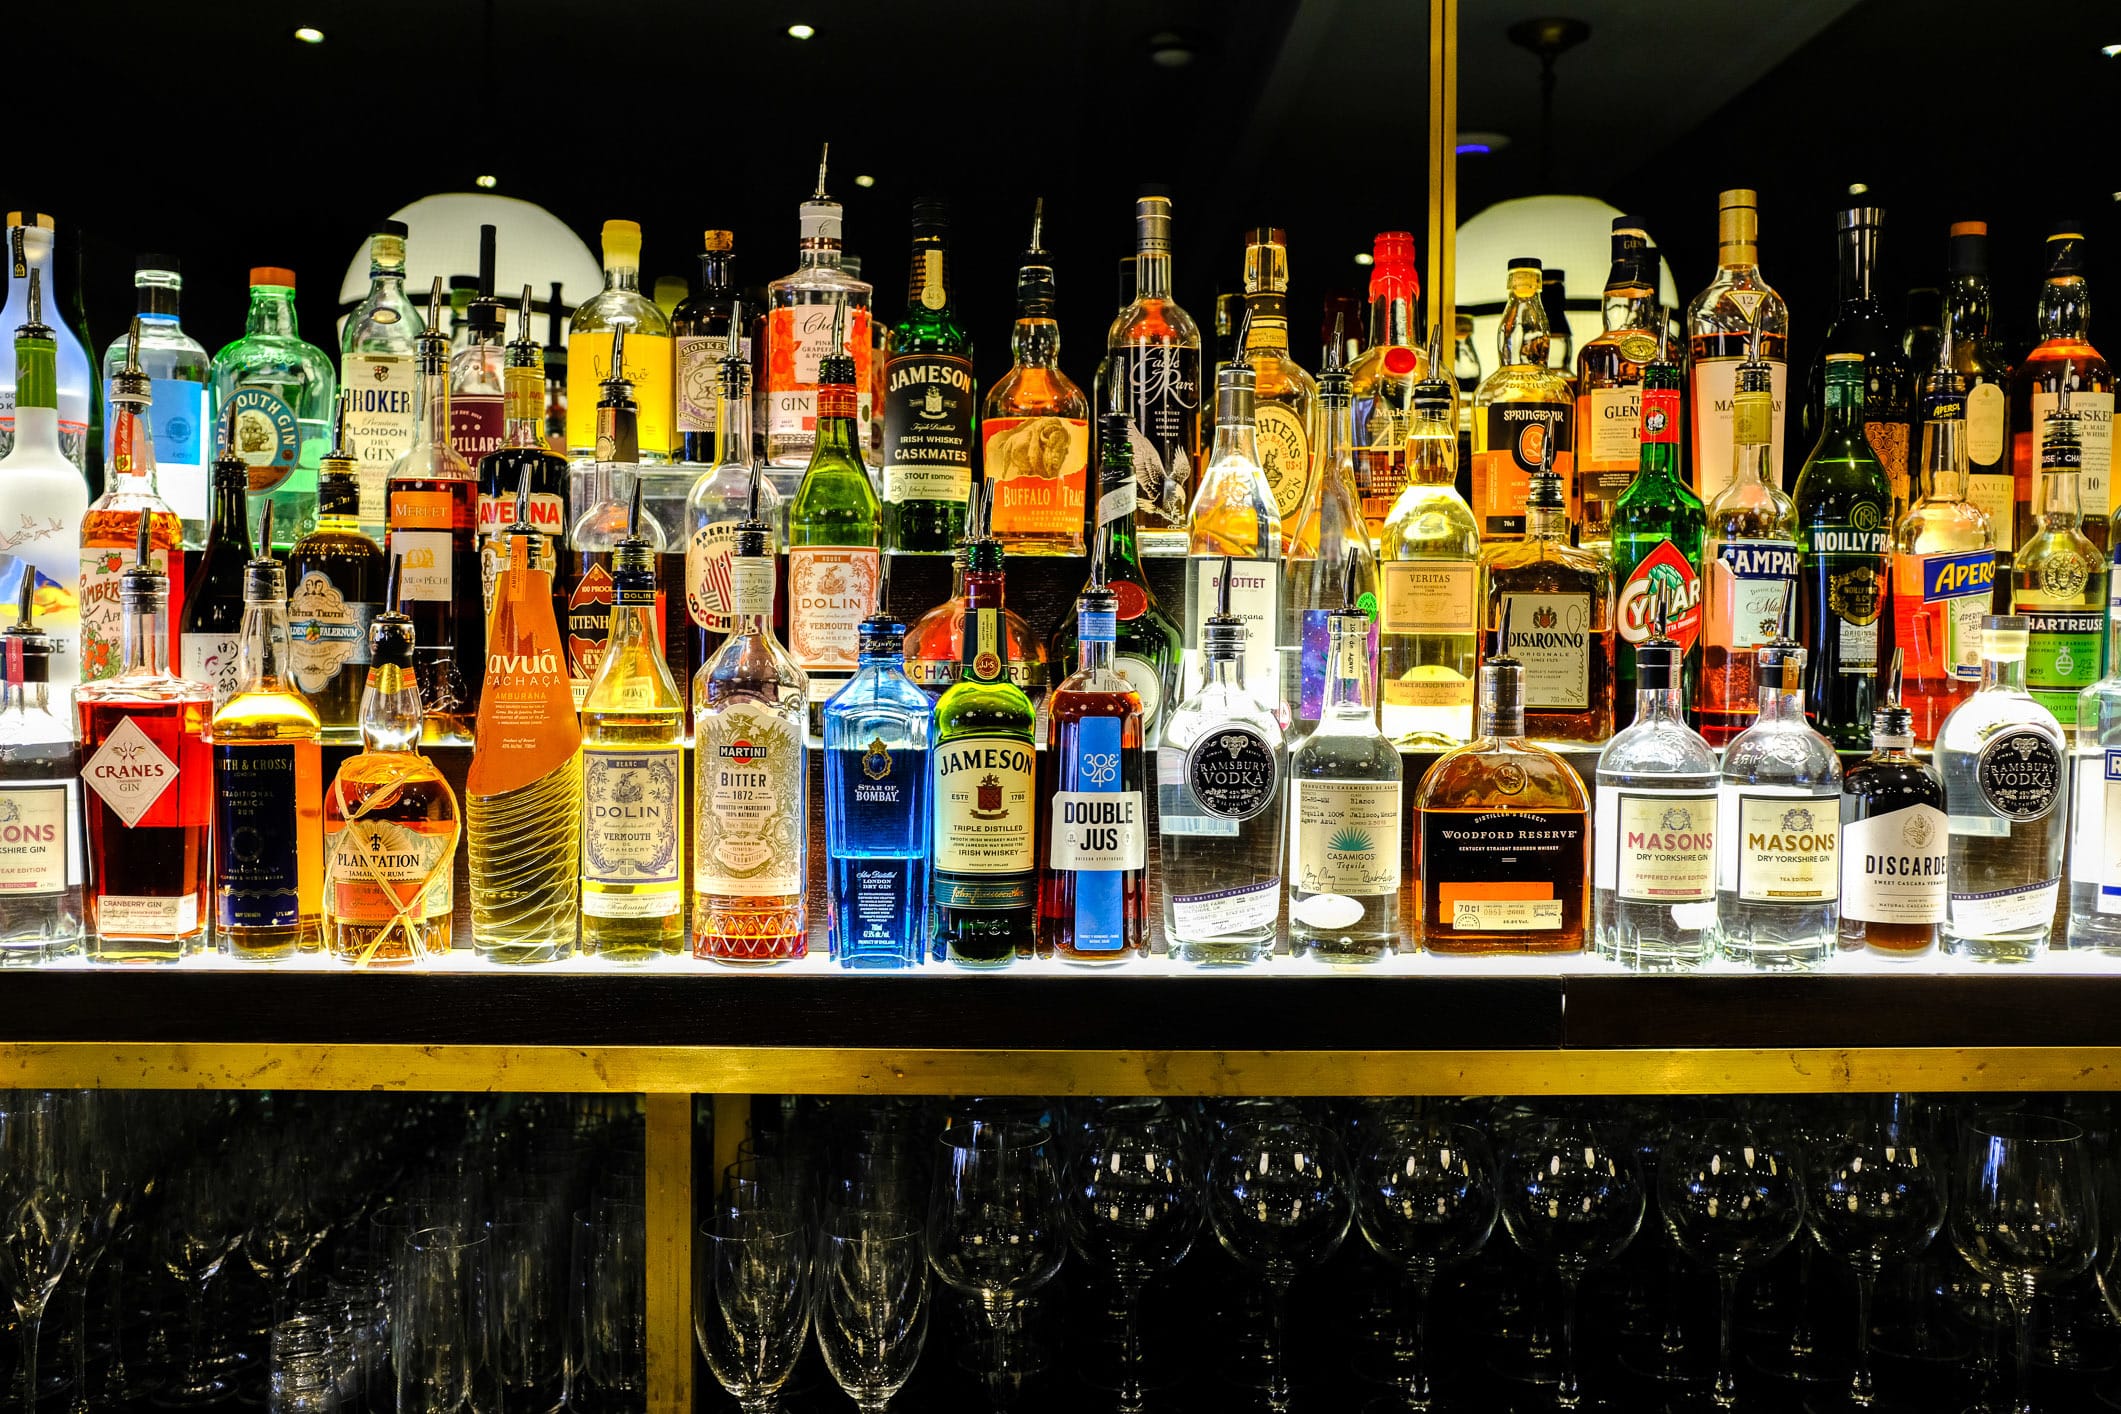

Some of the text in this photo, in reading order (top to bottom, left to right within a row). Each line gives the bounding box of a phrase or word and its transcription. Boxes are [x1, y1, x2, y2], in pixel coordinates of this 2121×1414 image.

[1742, 295, 1753, 305] 12
[803, 309, 833, 334] Cha
[681, 341, 729, 357] MONKEY
[889, 365, 971, 395] JAMESON
[344, 388, 411, 413] BROKER
[781, 397, 810, 411] GIN
[1714, 400, 1782, 412] MAAN
[217, 392, 297, 446] PLYOUTH GIN
[1375, 407, 1412, 418] Make
[2043, 409, 2113, 422] TISKER
[353, 426, 408, 438] LONDON
[370, 438, 390, 447] DRY
[900, 435, 964, 446] IRISH WHISKEY
[364, 446, 395, 462] GIN
[894, 448, 968, 463] CASKMATES
[904, 472, 954, 481] STOUT EDITION
[2087, 477, 2100, 490] 10
[1003, 486, 1050, 508] BUFFALO
[395, 503, 448, 518] MERLET
[480, 501, 561, 525] AVENA
[695, 526, 736, 546] APERI
[702, 534, 736, 550] AMERIC
[1814, 531, 1891, 552] NOILLY PRA
[1722, 548, 1799, 576] CAMPAR
[1409, 574, 1451, 583] VERITAS
[1934, 558, 1995, 593] APERO
[581, 585, 613, 593] 100 PROO
[1212, 577, 1266, 589] BOTTET
[802, 598, 861, 609] DOLIN
[315, 609, 344, 619] TRUTH
[688, 593, 732, 628] COCCHI
[809, 622, 853, 631] VERMOUTH
[2029, 617, 2104, 631] HARTREUSE
[291, 627, 359, 639] LDEN FALERNUM
[1510, 632, 1584, 649] DISARONNO
[488, 648, 558, 675] avuá
[582, 653, 603, 665] RY
[913, 665, 1032, 681] CHARD
[486, 675, 561, 688] CACHAÇA
[495, 692, 547, 700] AMBURANA
[720, 746, 766, 757] MARTINI
[216, 758, 287, 771] ITH & CROSS
[940, 748, 1033, 777] JAMESON
[1200, 761, 1267, 773] RAMSBURY
[1990, 762, 2055, 773] RAMSBURY
[94, 764, 164, 779] CRANES
[721, 772, 767, 787] BITTER
[1202, 771, 1264, 787] VODKA
[1993, 772, 2053, 788] VODKA
[119, 782, 140, 792] GIN
[732, 790, 753, 801] 1872
[855, 790, 899, 802] BOMBAY
[595, 806, 660, 818] DOLIN
[1064, 801, 1134, 824] DOUBLE
[1301, 809, 1325, 818] Tequila
[1474, 812, 1547, 824] DISTILLER'S SELECT
[0, 824, 56, 844] ONS
[953, 824, 1023, 832] TRIPLE DISTILLED
[1442, 830, 1576, 839] WOODFORD RESERVE
[604, 832, 651, 841] VERMOUTH
[1080, 828, 1118, 851] JUS
[1628, 831, 1713, 851] MASONS
[1749, 832, 1835, 852] MASONS
[958, 849, 1019, 857] IRISH WHISKEY
[1326, 852, 1376, 861] CASAMIGOS
[1636, 853, 1652, 861] DRY
[1654, 853, 1697, 862] YORKSHIRE
[1757, 854, 1830, 863] DRY YORKSHIRE GIN
[337, 853, 420, 868] PLANTATION
[1336, 861, 1366, 872] Tequila
[1865, 854, 1948, 877] DISCARDE
[1635, 873, 1669, 881] PEPPERED
[103, 900, 146, 908] CRANBERRY
[1458, 904, 1480, 913] 70cl
